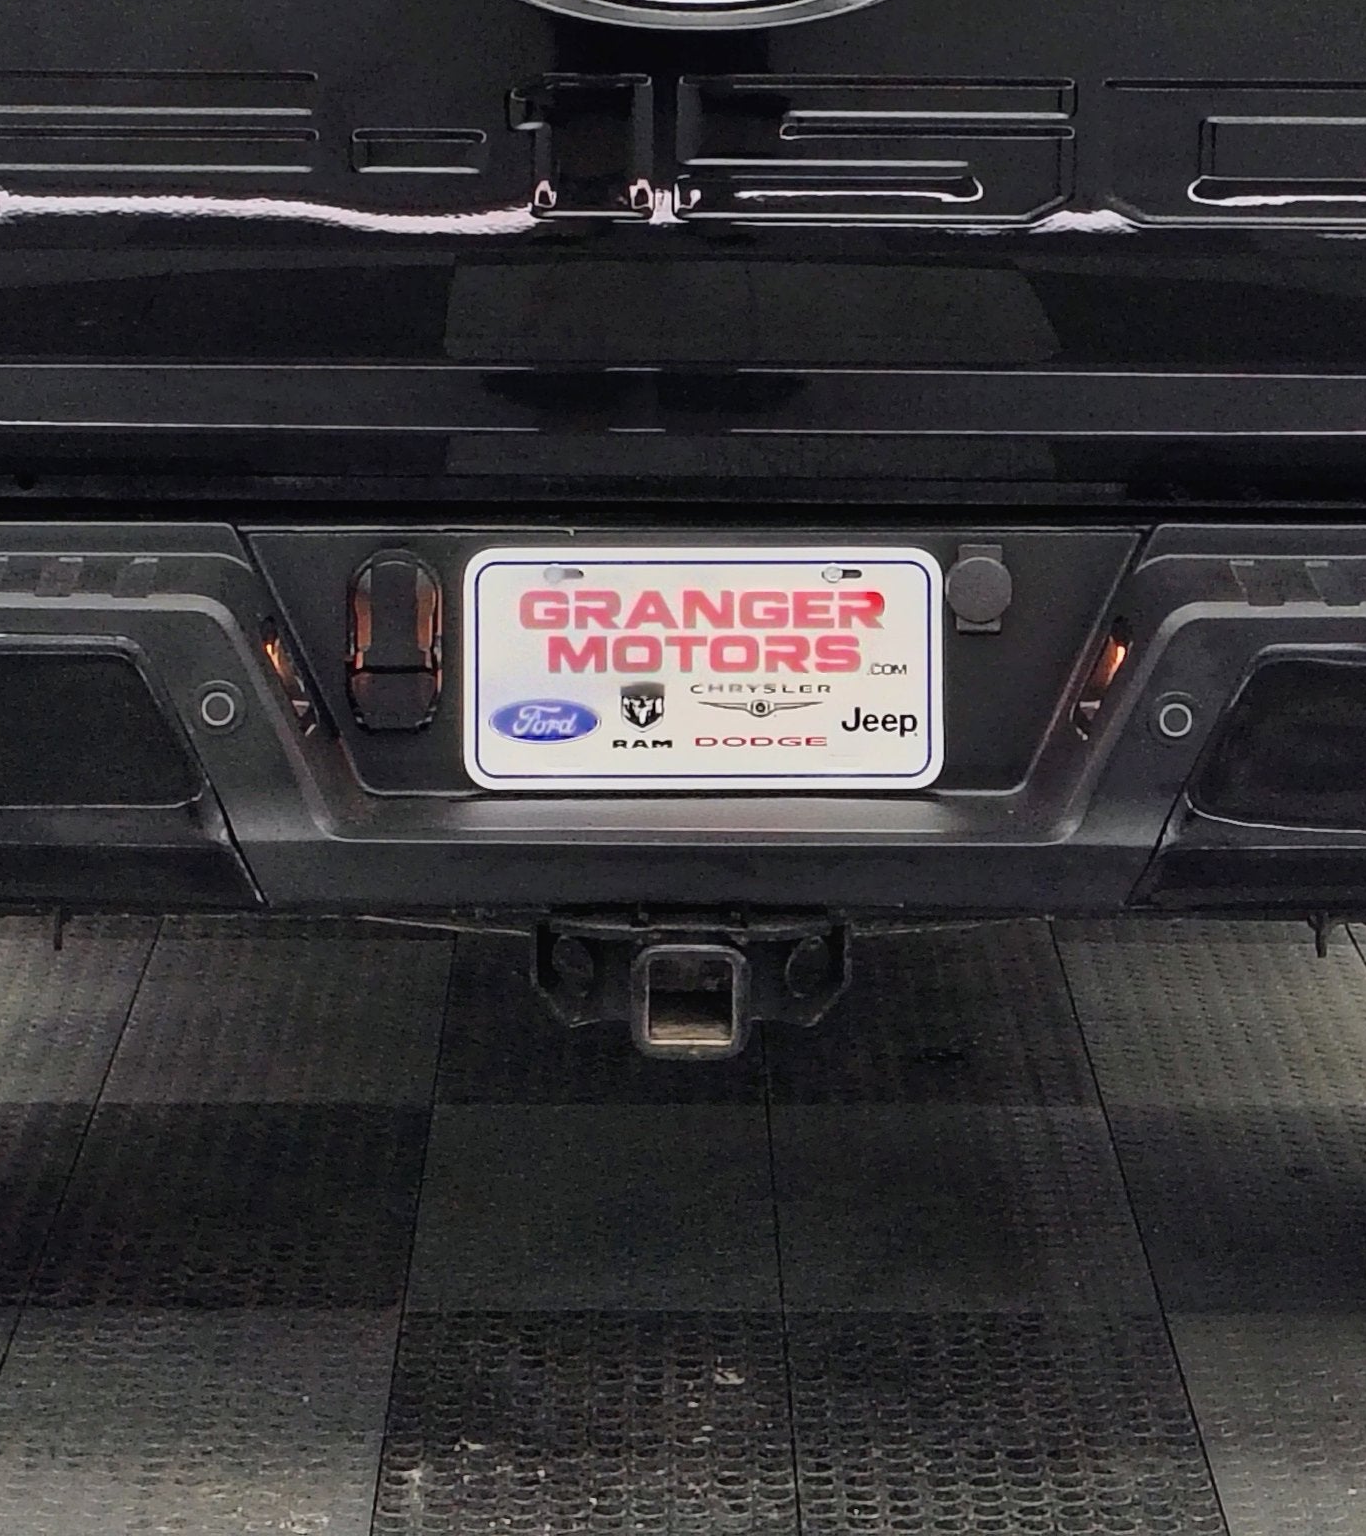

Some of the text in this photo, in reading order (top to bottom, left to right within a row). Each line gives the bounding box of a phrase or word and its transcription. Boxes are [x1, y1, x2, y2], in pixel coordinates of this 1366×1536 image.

[519, 589, 885, 631] GRANGER
[547, 634, 863, 675] MOTORS
[689, 683, 832, 695] CHRYSLER
[511, 705, 578, 738] Ford
[841, 706, 918, 737] Jeep
[611, 739, 674, 750] RAM
[694, 736, 828, 748] DODGE
